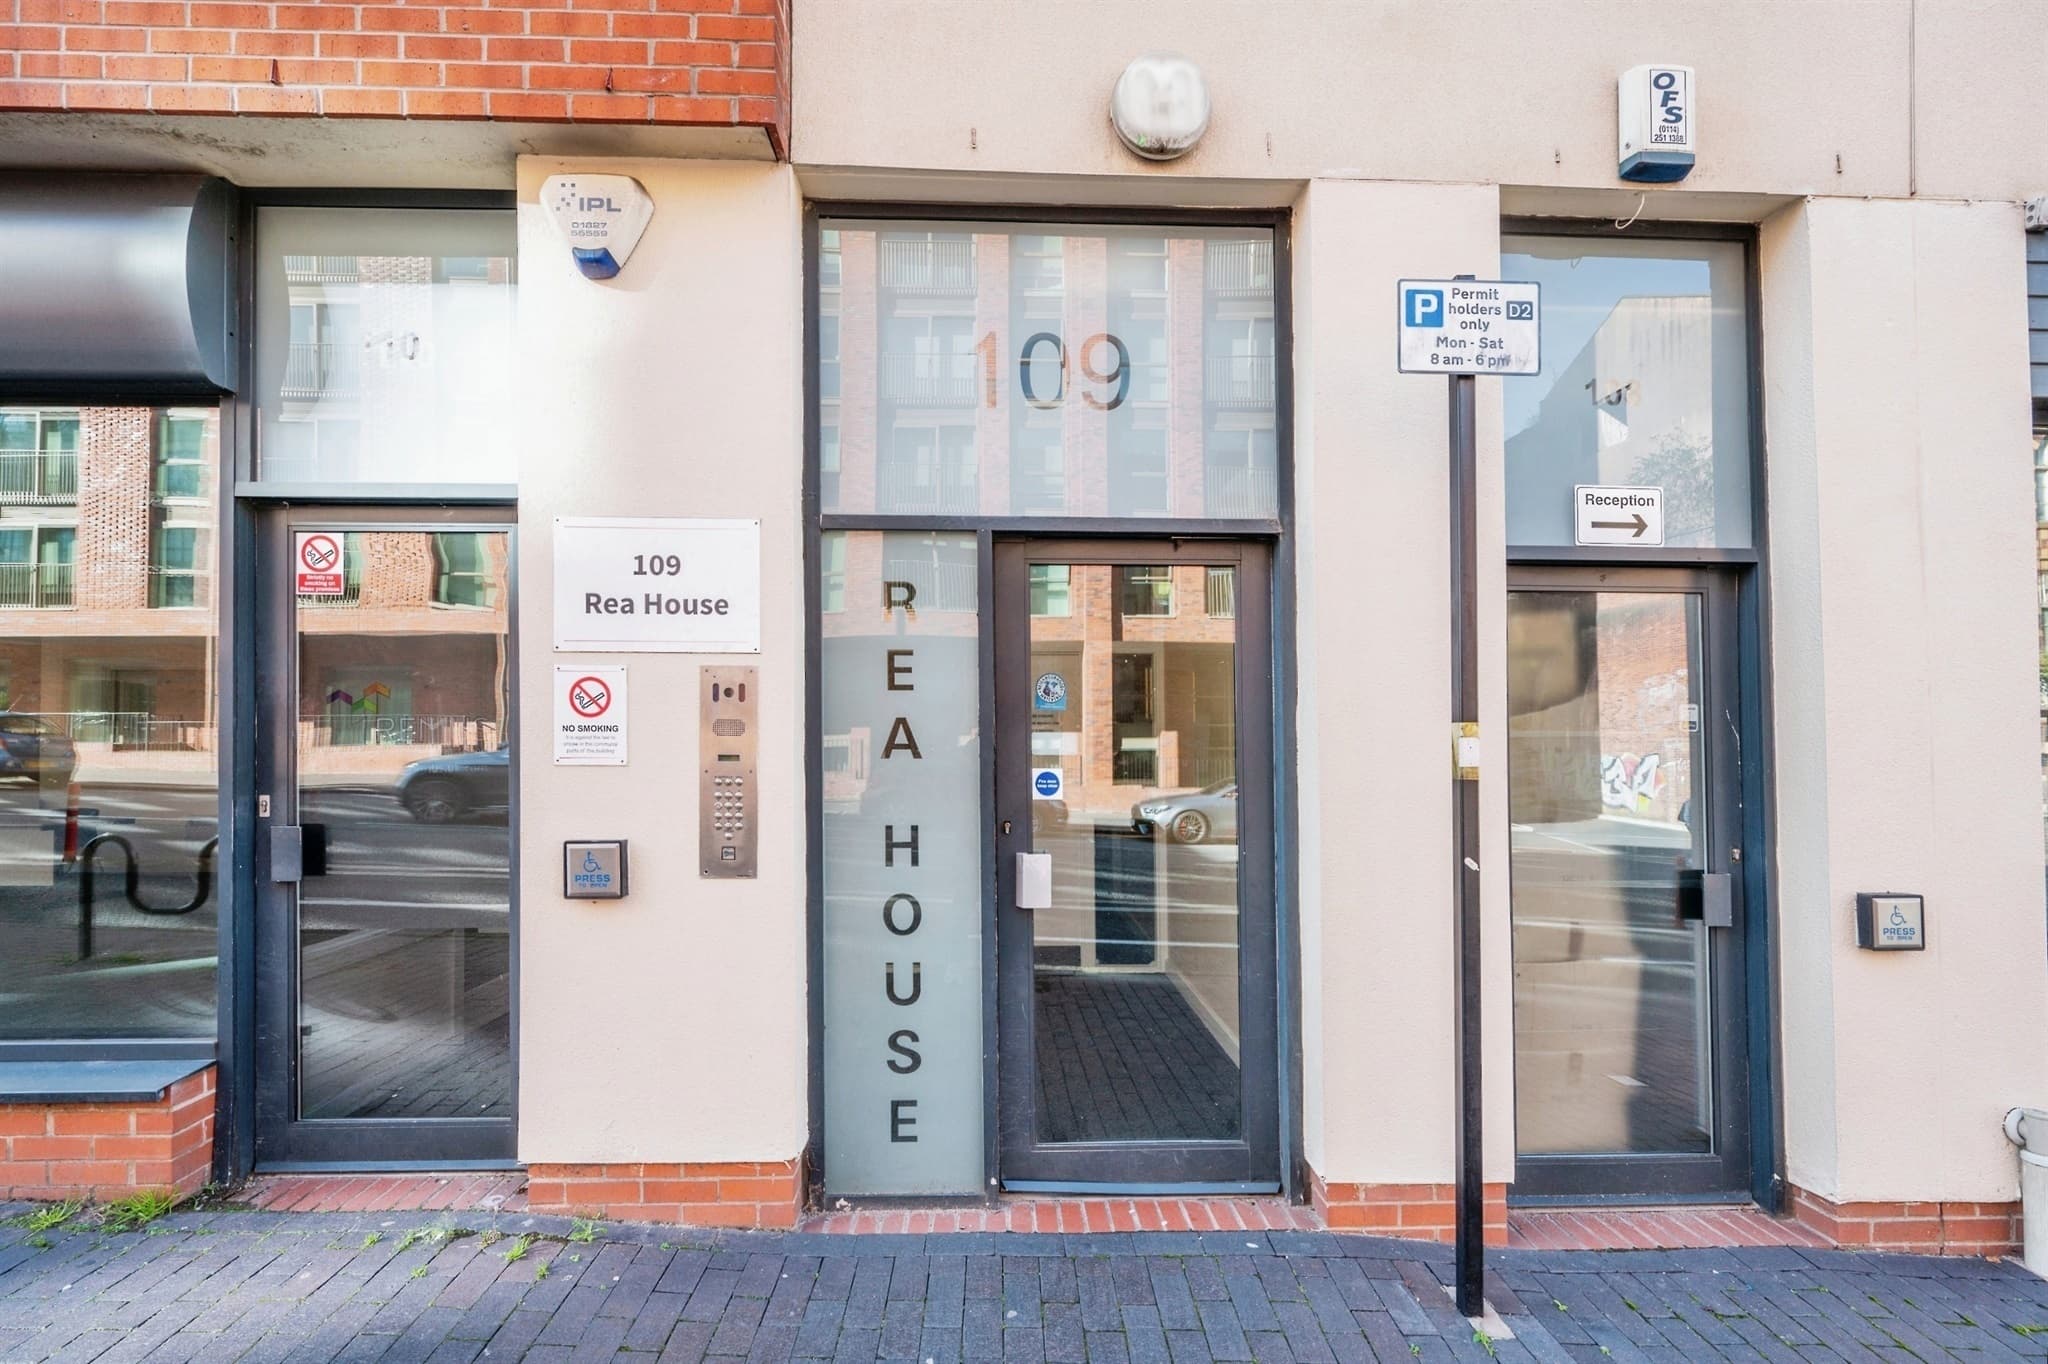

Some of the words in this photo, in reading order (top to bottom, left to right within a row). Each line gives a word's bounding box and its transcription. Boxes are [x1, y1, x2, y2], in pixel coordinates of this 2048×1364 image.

[1653, 72, 1683, 124] OFS
[1658, 125, 1680, 134] (0114)
[1654, 134, 1667, 142] 251
[579, 197, 622, 212] IPL
[1452, 287, 1499, 300] Permit
[1414, 293, 1439, 325] P
[1448, 303, 1502, 316] holders
[1509, 303, 1532, 318] D2
[1460, 319, 1490, 333] only
[1436, 336, 1467, 349] Mon
[1478, 337, 1504, 350] Sat
[1430, 353, 1440, 365] 8
[1442, 355, 1464, 365] am
[1475, 354, 1485, 366] 6
[976, 331, 1131, 411] 109
[1585, 493, 1655, 509] Reception
[633, 554, 681, 576] 109
[585, 592, 635, 614] Rea
[644, 593, 729, 615] House
[880, 581, 923, 759] REA
[562, 724, 576, 733] NO
[577, 724, 619, 733] SMOKING
[575, 874, 611, 882] PRESS
[1882, 927, 1916, 936] PRESS
[882, 825, 922, 1142] HOUSE
